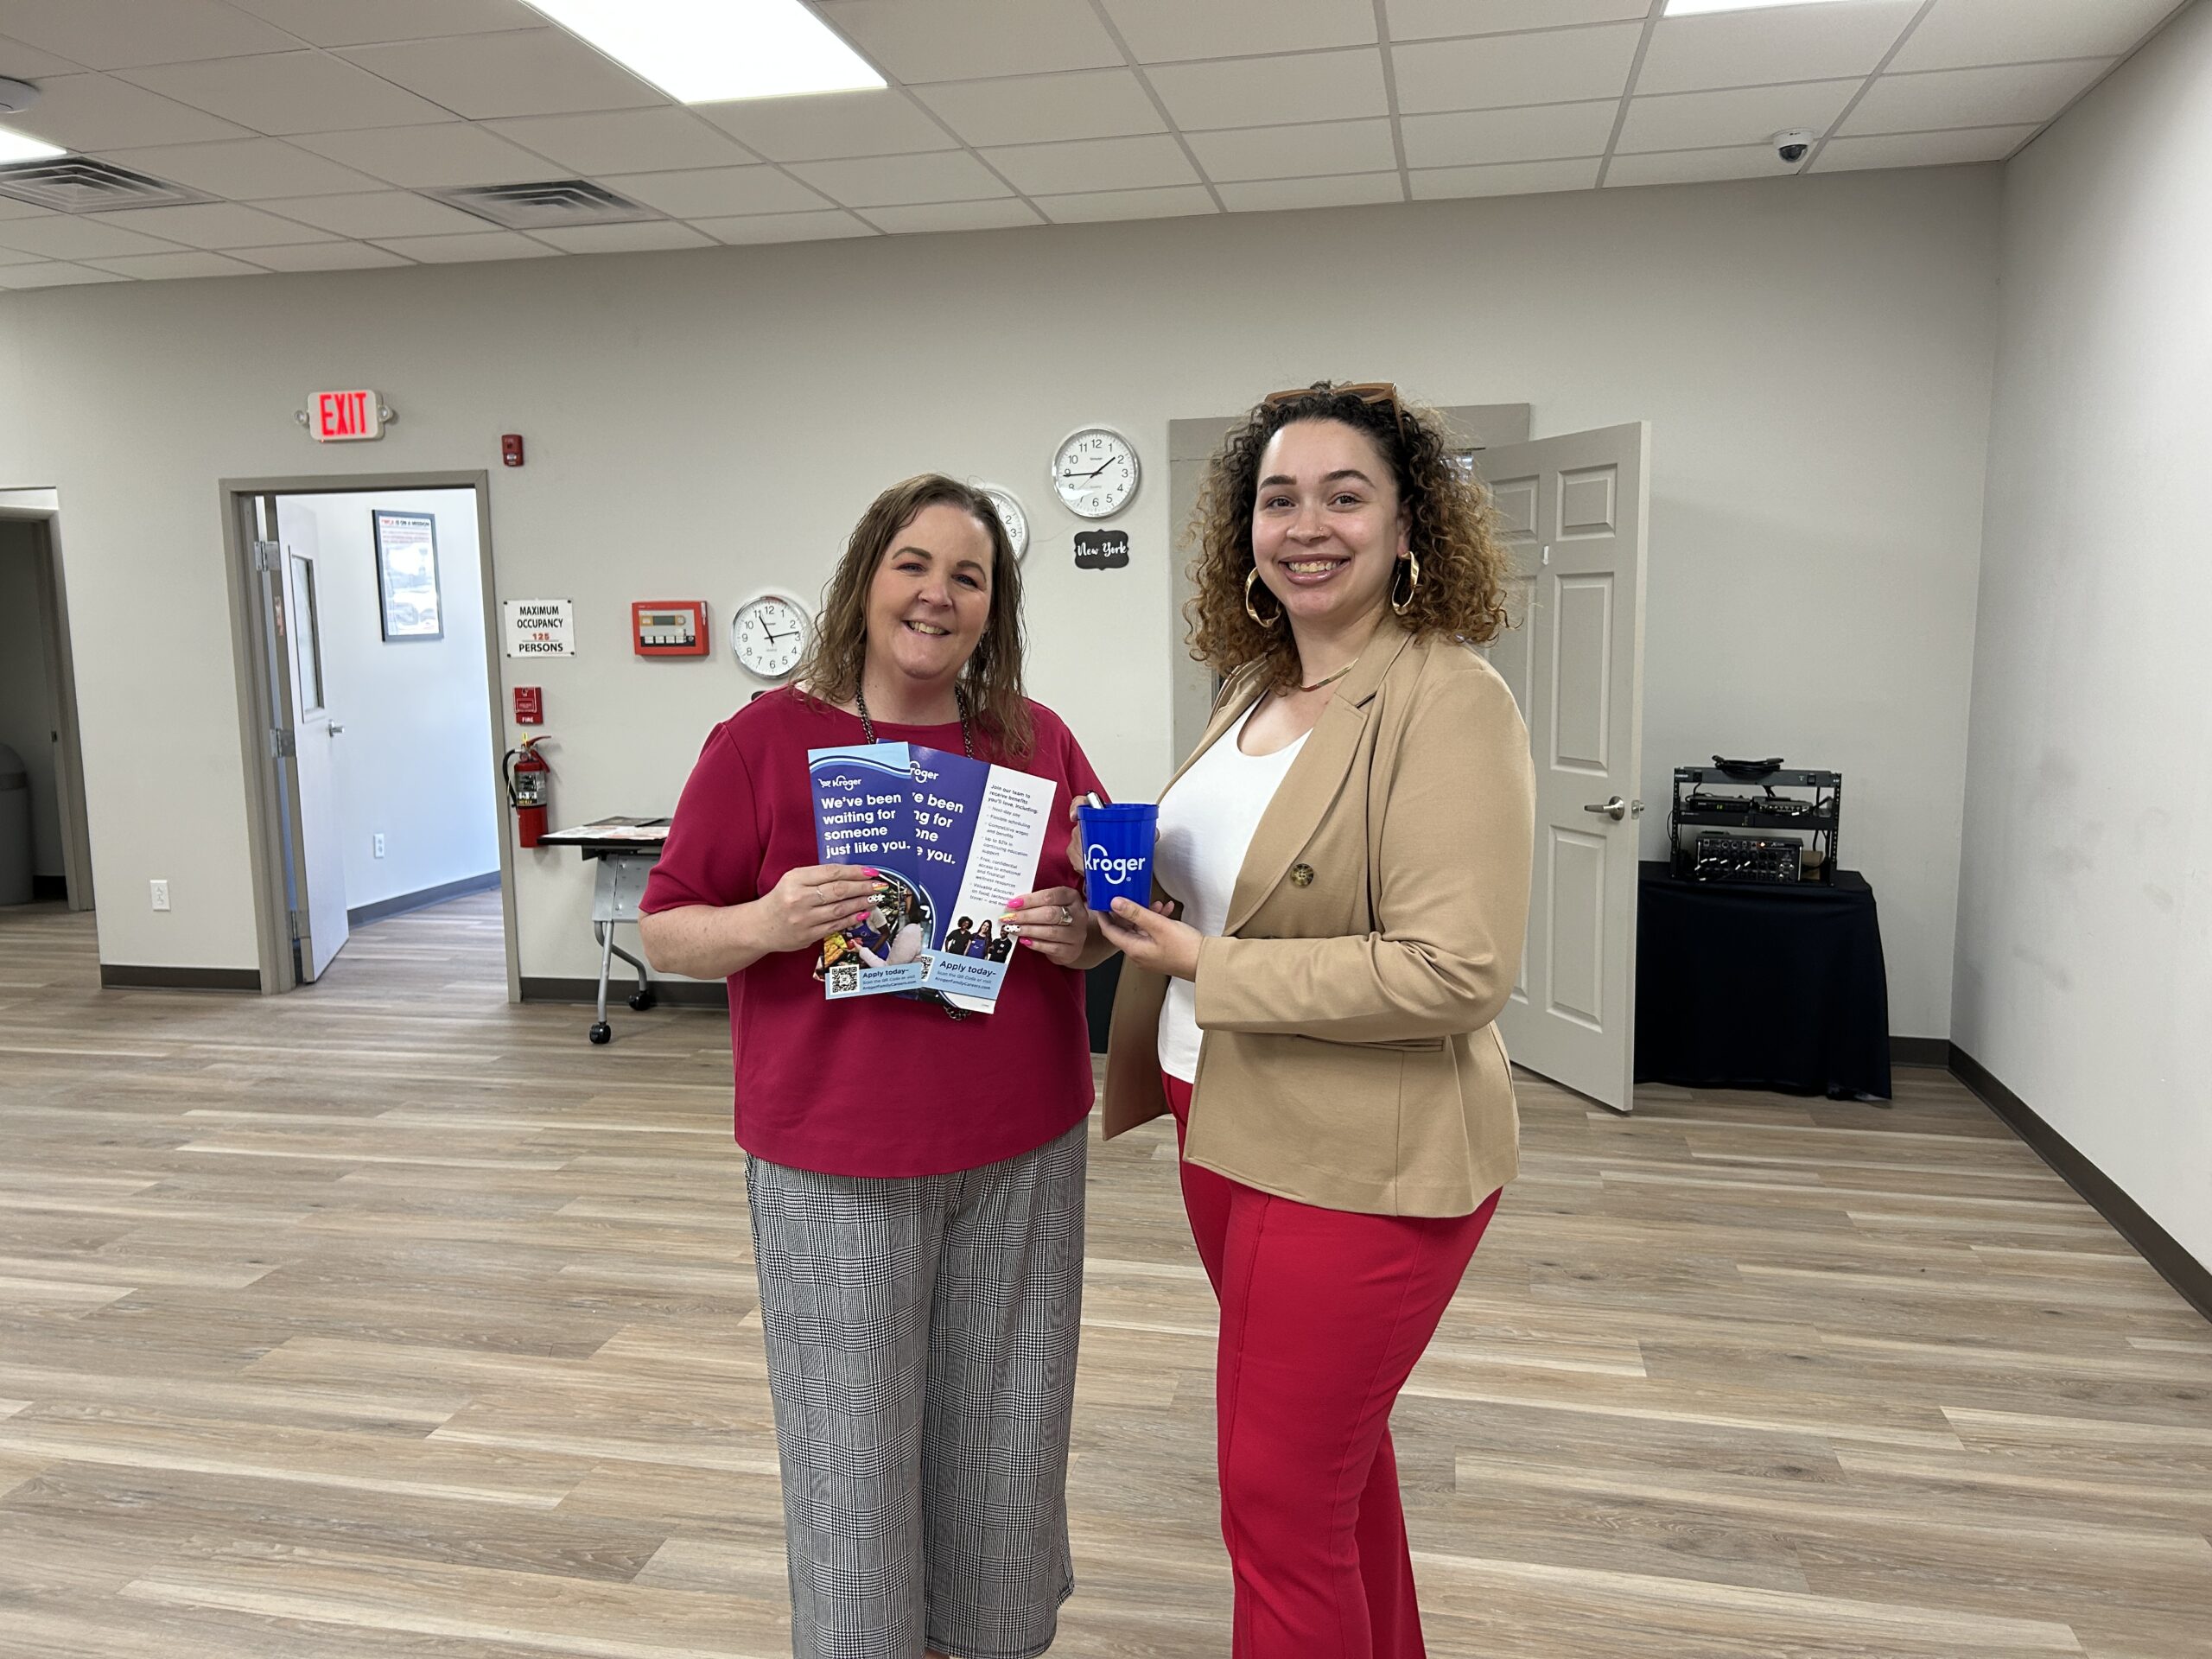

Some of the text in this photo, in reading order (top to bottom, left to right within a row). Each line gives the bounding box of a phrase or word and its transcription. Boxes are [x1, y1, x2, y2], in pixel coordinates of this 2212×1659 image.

[319, 391, 366, 436] EXIT
[1079, 442, 1088, 453] 11
[1091, 438, 1103, 448] 12
[1108, 442, 1112, 453] 1
[1068, 454, 1078, 465] 10
[1117, 454, 1124, 465] 2
[1122, 468, 1128, 478] 3
[1092, 498, 1099, 507] 6
[1106, 493, 1113, 503] 5
[1005, 515, 1012, 524] 2
[1010, 528, 1017, 537] 3
[1077, 541, 1127, 557] New York
[519, 606, 559, 616] MAXIMUM
[753, 609, 761, 619] 11
[765, 606, 775, 615] 12
[517, 618, 563, 628] OCCUPANCY
[745, 620, 754, 630] 10
[790, 620, 796, 629] 2
[532, 632, 550, 641] 125
[741, 633, 748, 642] 9
[795, 632, 801, 641] 3
[518, 643, 563, 652] PERSONS
[746, 647, 753, 656] 8
[791, 646, 797, 655] 4
[756, 656, 763, 665] 7
[769, 659, 776, 669] 6
[781, 656, 788, 665] 5
[832, 775, 861, 791] Kroger
[821, 797, 863, 810] We've
[866, 794, 902, 805] been
[927, 793, 963, 813] been
[1008, 795, 1028, 804] benefits
[823, 809, 896, 824] waiting for
[932, 812, 953, 828] for
[823, 826, 888, 841] someone
[825, 843, 851, 859] just
[854, 842, 878, 854] like
[881, 841, 911, 853] you.
[925, 849, 957, 864] you.
[1084, 843, 1146, 885] Kroger
[939, 960, 966, 973] Apply
[862, 970, 884, 979] Apply
